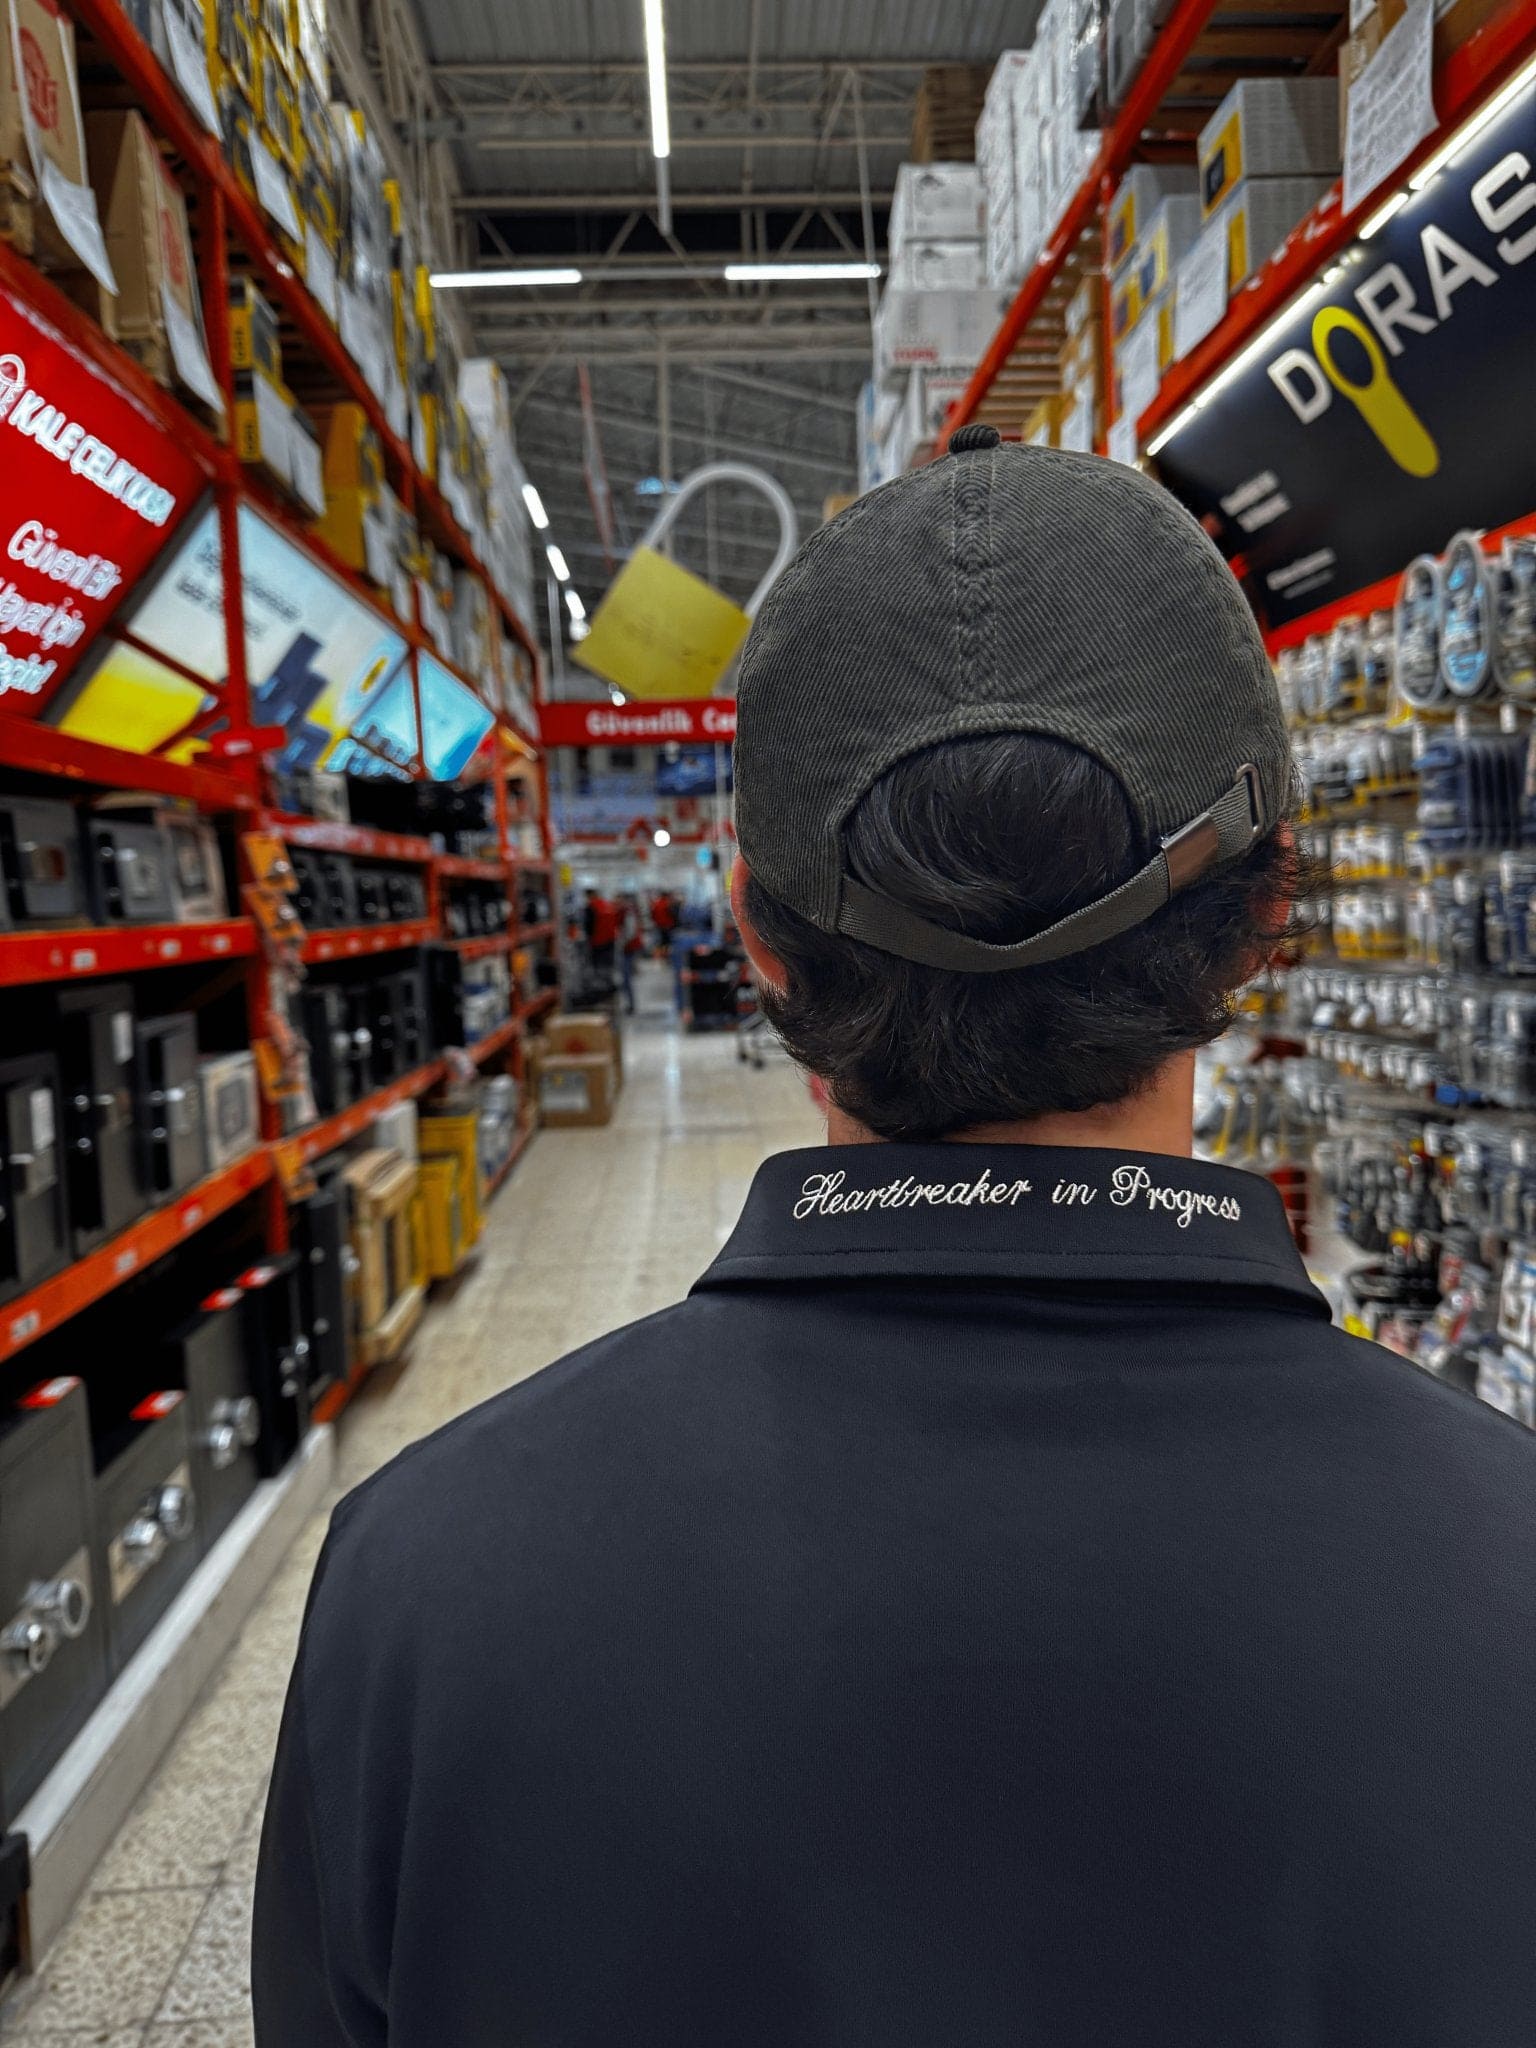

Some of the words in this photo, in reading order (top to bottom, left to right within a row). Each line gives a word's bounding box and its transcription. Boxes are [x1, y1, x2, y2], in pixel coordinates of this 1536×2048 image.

[8, 389, 86, 462] KALE
[586, 708, 693, 737] Güvenlik
[793, 1168, 1031, 1219] Heartbreaker
[1051, 1177, 1097, 1206] in
[1111, 1164, 1241, 1228] Progress
